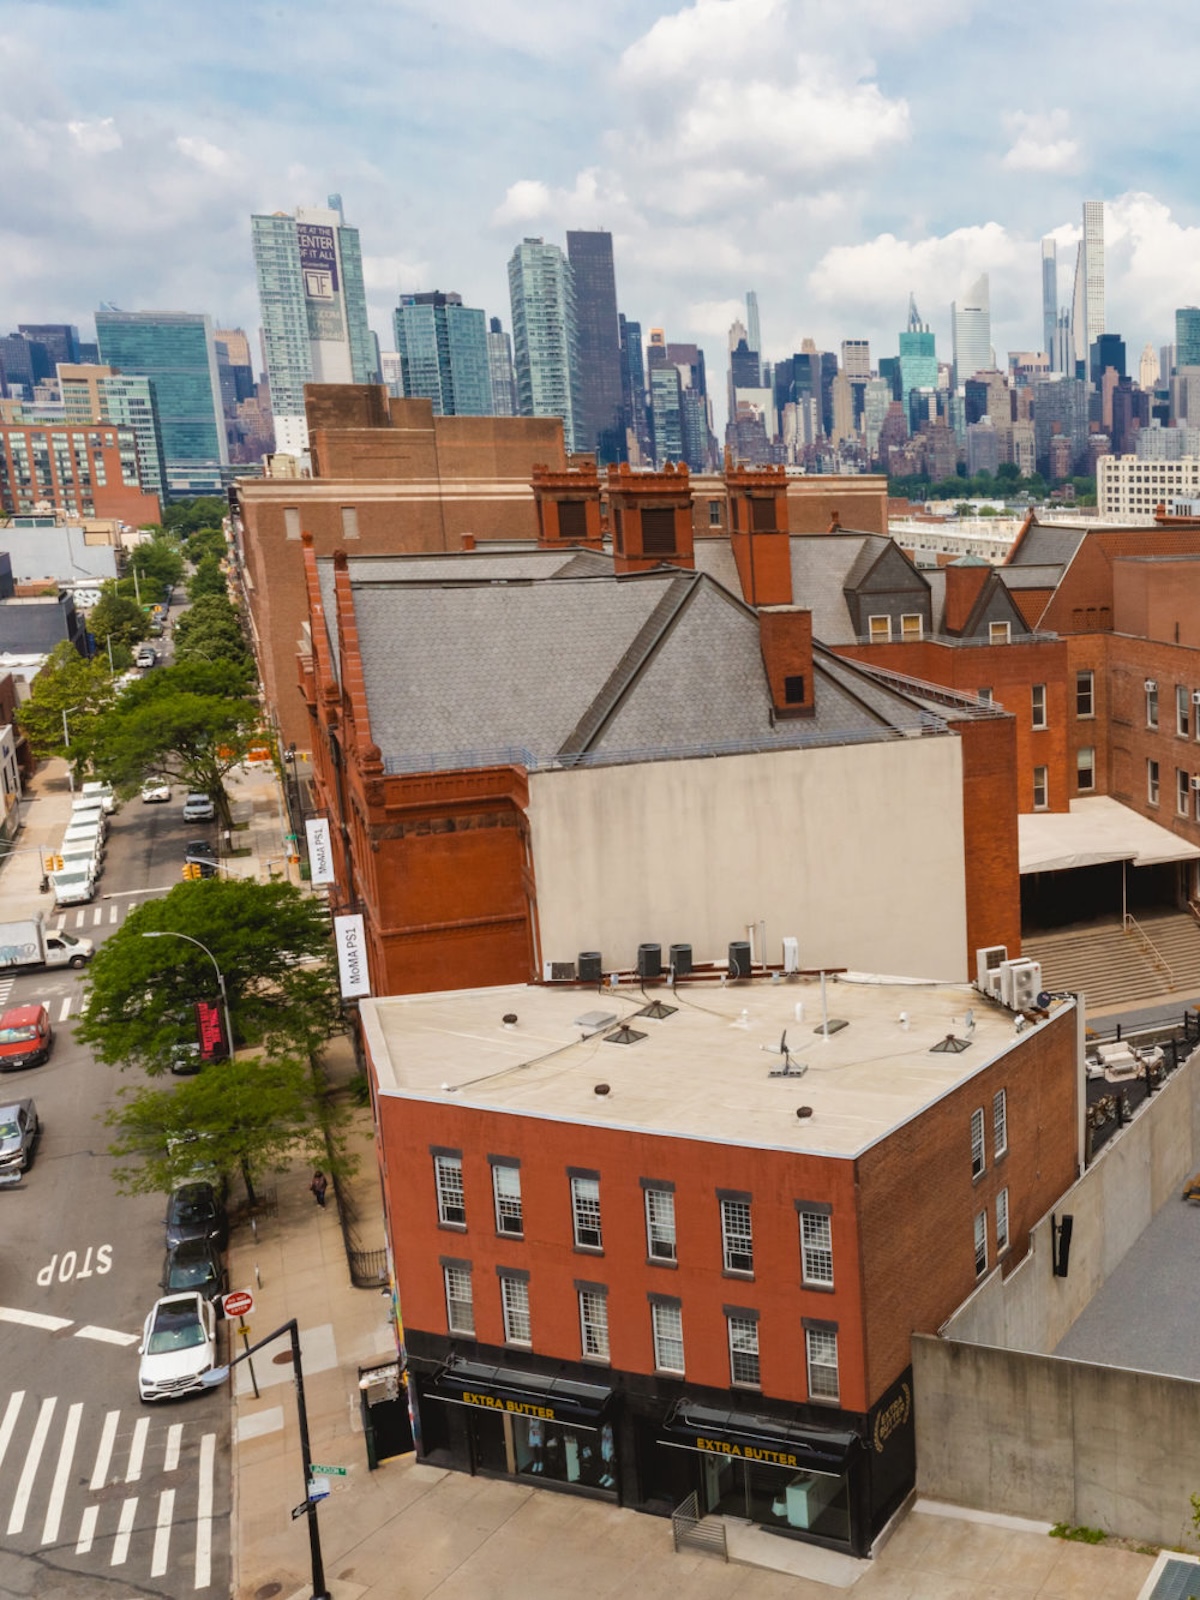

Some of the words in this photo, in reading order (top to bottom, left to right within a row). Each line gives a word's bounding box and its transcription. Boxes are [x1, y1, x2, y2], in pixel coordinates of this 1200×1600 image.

[345, 927, 358, 949] PS1
[347, 949, 361, 984] MoMA
[36, 1243, 113, 1287] STOP
[462, 1391, 504, 1410] EXTRA
[505, 1400, 555, 1420] BUTTER
[696, 1437, 742, 1456] EXTRA
[744, 1446, 798, 1467] BUTTER
